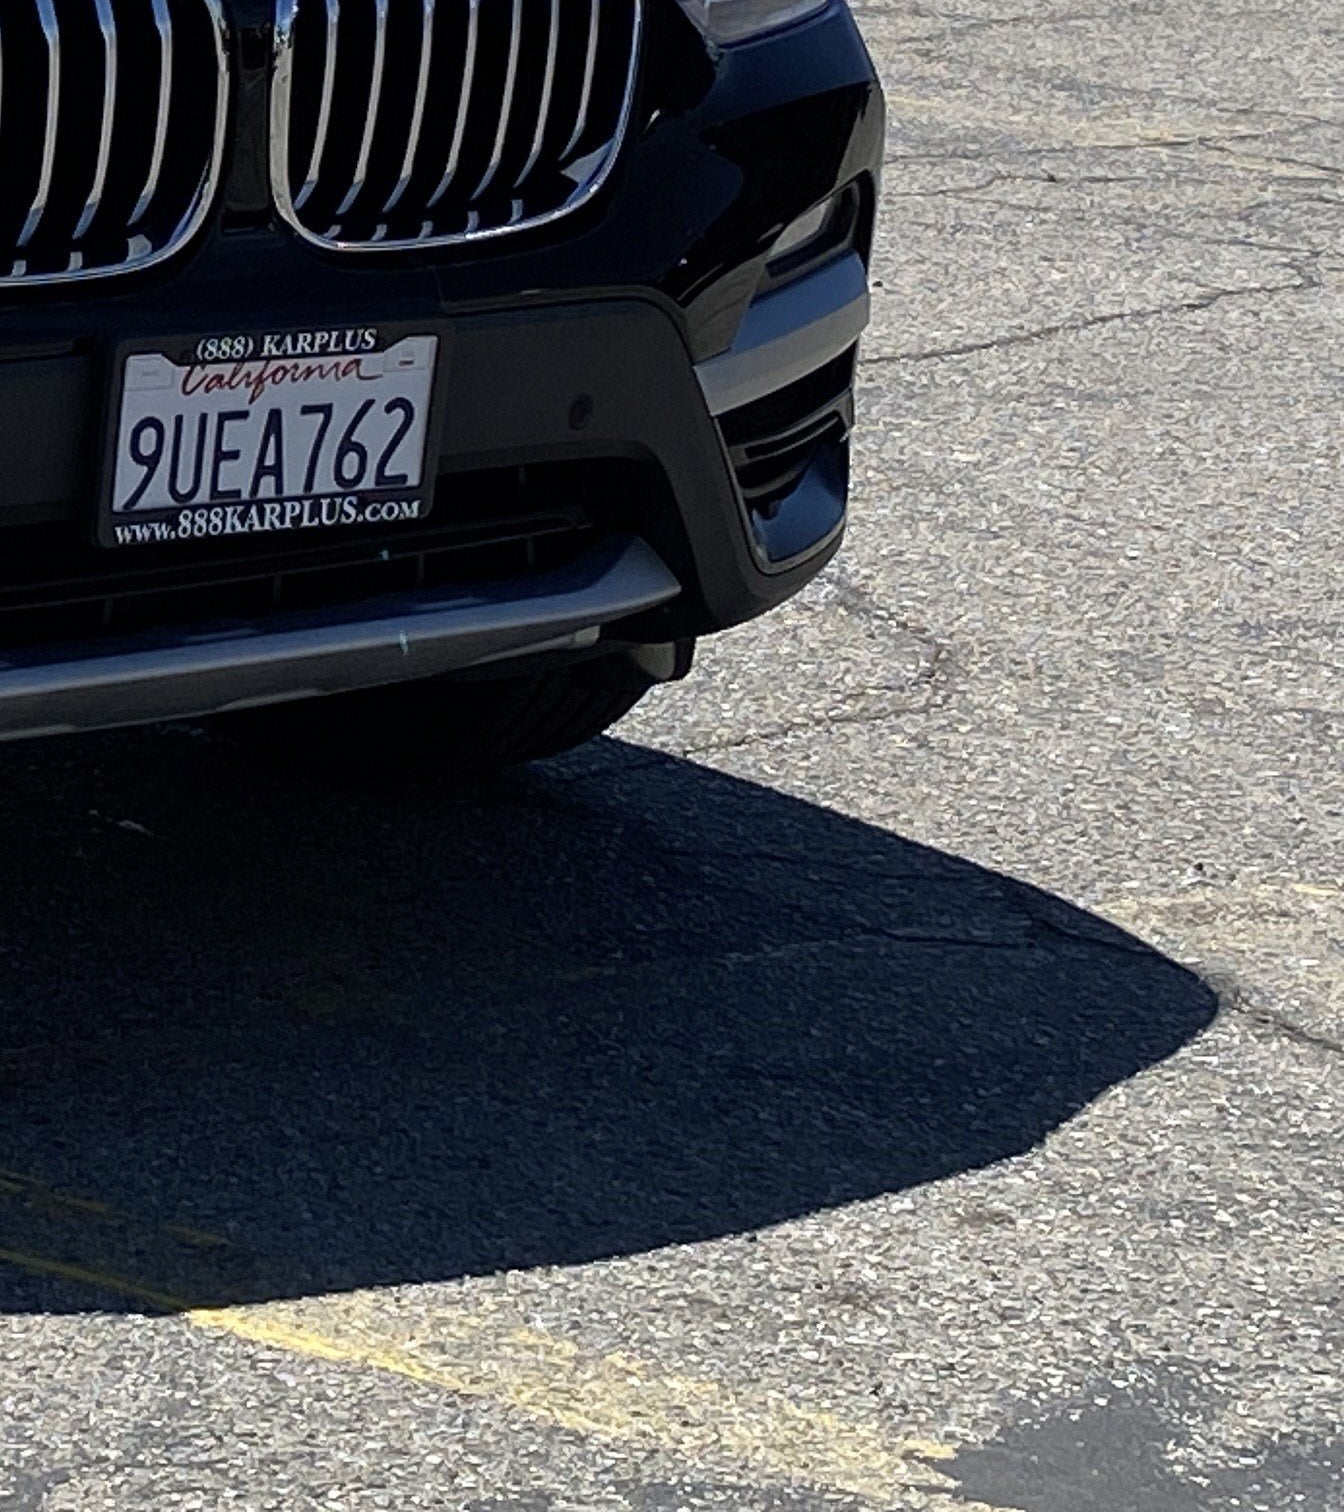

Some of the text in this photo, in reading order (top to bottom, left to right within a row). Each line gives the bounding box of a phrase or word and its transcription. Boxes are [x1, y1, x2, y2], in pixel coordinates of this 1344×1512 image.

[196, 328, 378, 361] (888) KARPLUS
[181, 357, 383, 405] California
[122, 397, 415, 511] 9UEA762
